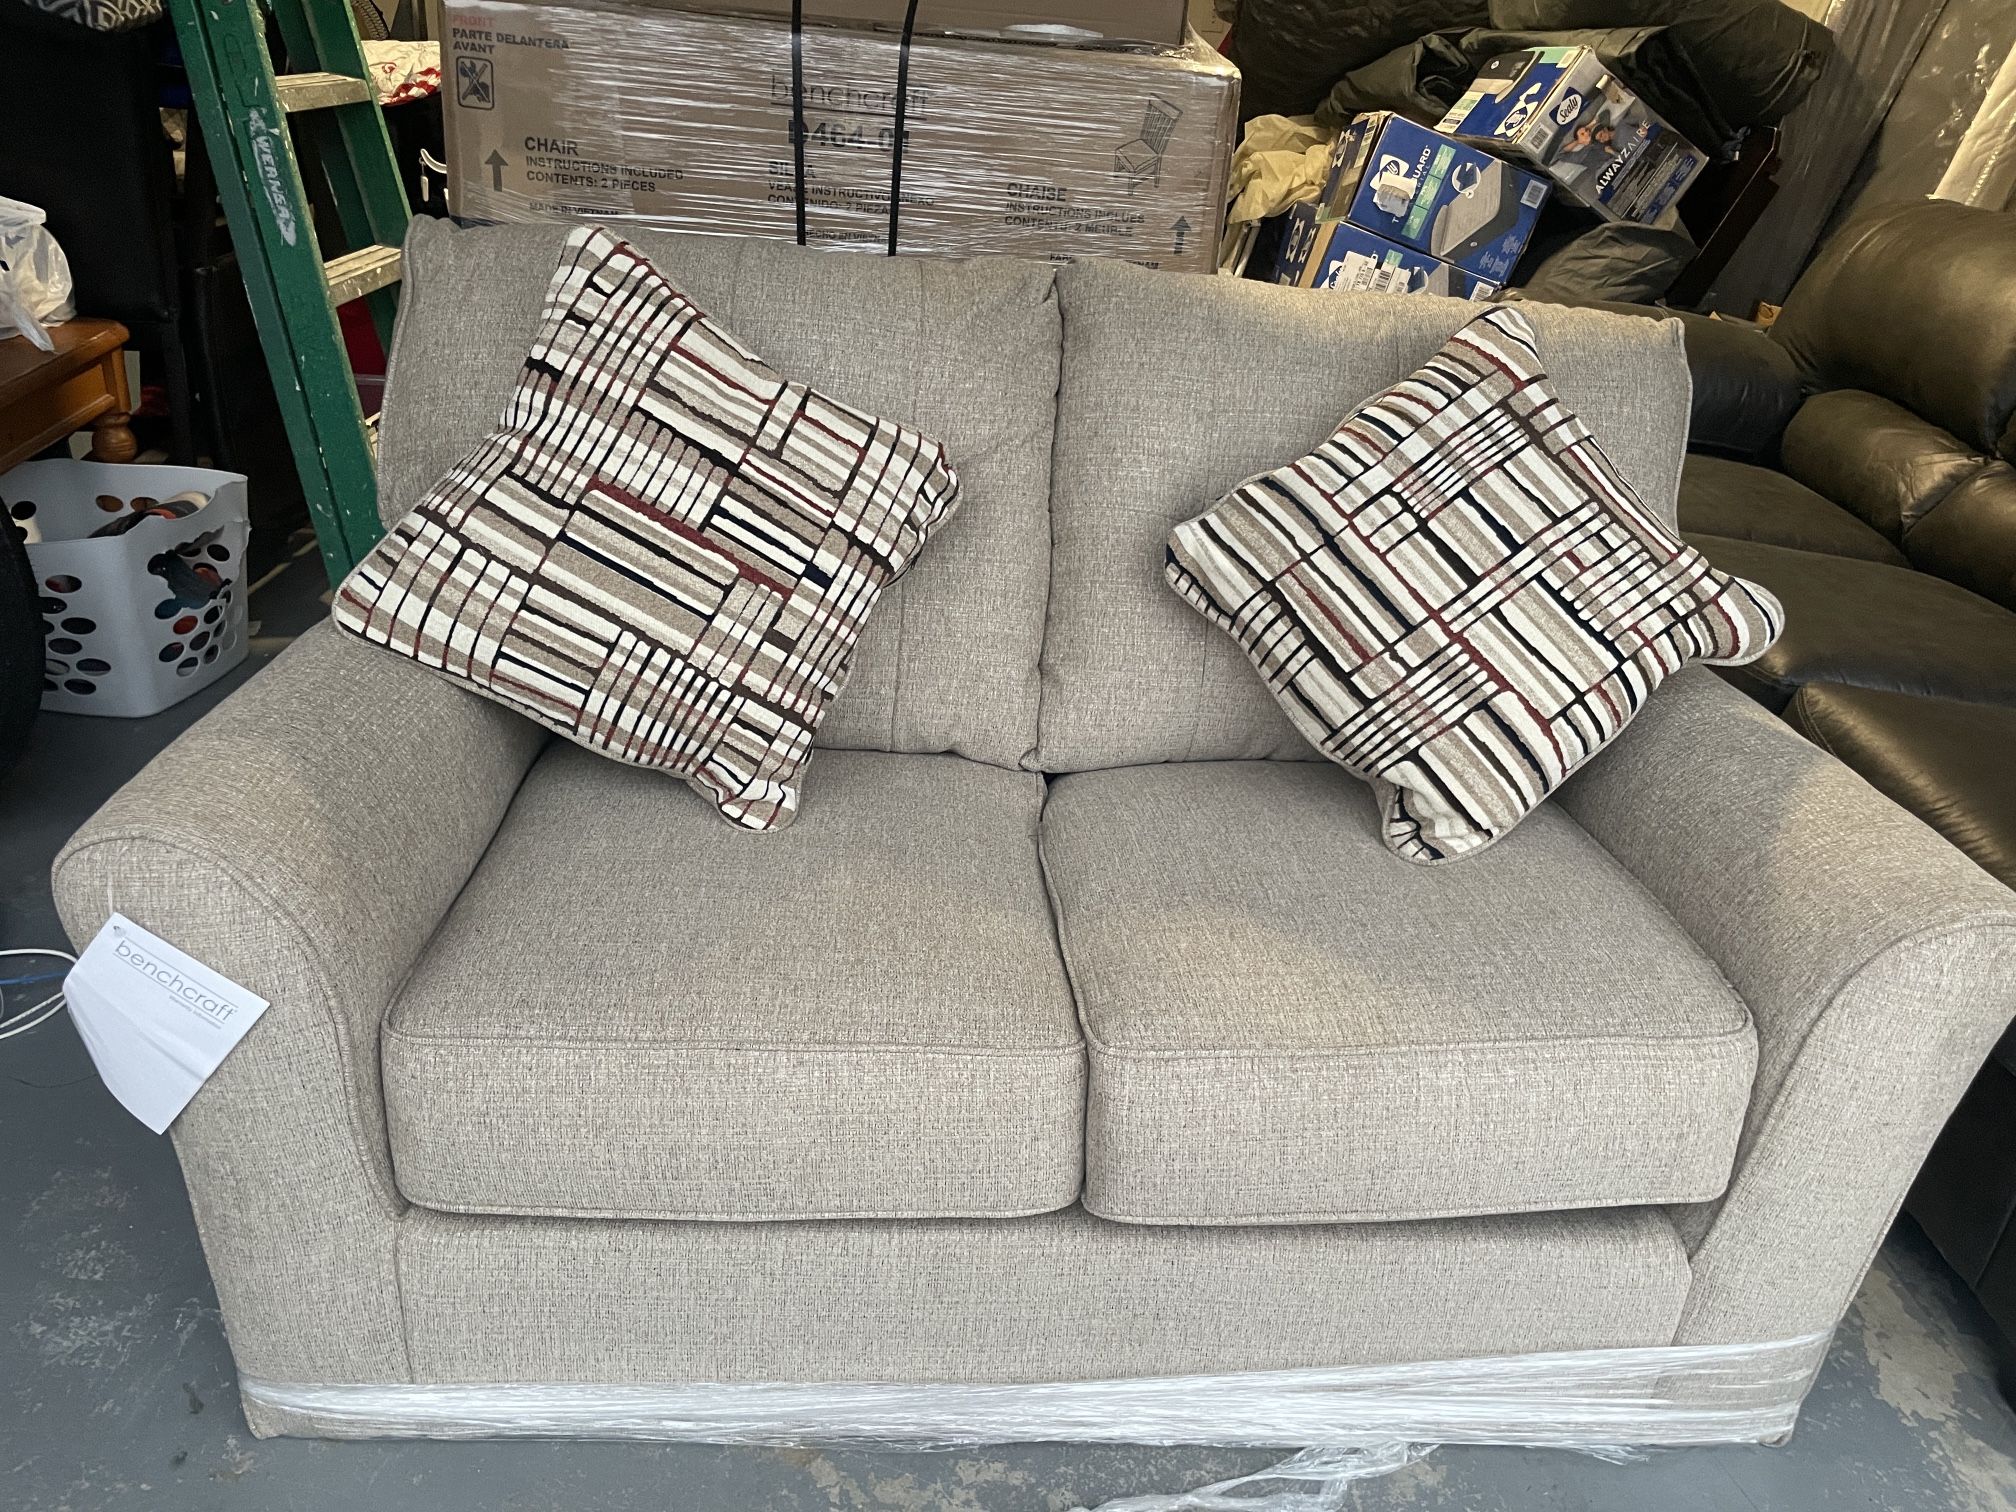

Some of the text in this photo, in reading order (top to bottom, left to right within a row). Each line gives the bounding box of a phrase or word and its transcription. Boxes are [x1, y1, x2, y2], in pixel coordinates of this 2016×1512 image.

[452, 14, 497, 27] FRONT
[453, 28, 570, 49] PARTE DELANTERA
[453, 41, 495, 54] AVANT
[771, 70, 928, 109] bnchcrft
[1559, 96, 1579, 122] Sealy
[524, 136, 579, 156] CHAIR
[526, 156, 684, 180] INSTRUCTIONS INCLUDED
[768, 161, 816, 178] SILA
[526, 170, 656, 192] CONTENTS: 2 PIECES
[768, 180, 809, 195] VEAE
[1007, 183, 1067, 201] CHAISE
[855, 203, 889, 214] PIEZA
[1006, 202, 1091, 219] INSTRUCTIONS
[115, 940, 234, 1020] benchcraft
